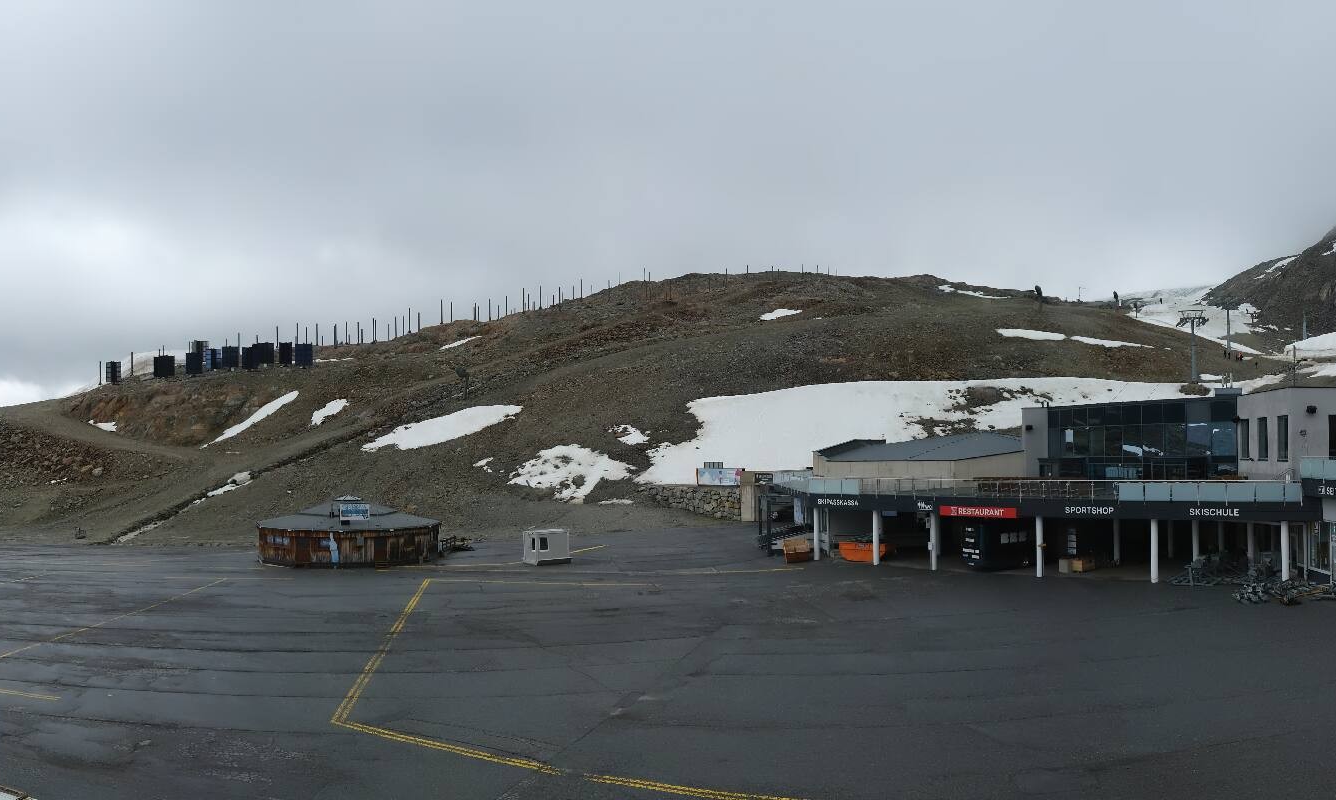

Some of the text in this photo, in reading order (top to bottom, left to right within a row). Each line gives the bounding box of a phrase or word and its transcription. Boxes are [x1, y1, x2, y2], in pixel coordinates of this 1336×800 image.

[958, 508, 1004, 516] RESTAURANT
[1065, 506, 1114, 515] SPORTSHOP
[1189, 508, 1240, 517] SKISCHULE
